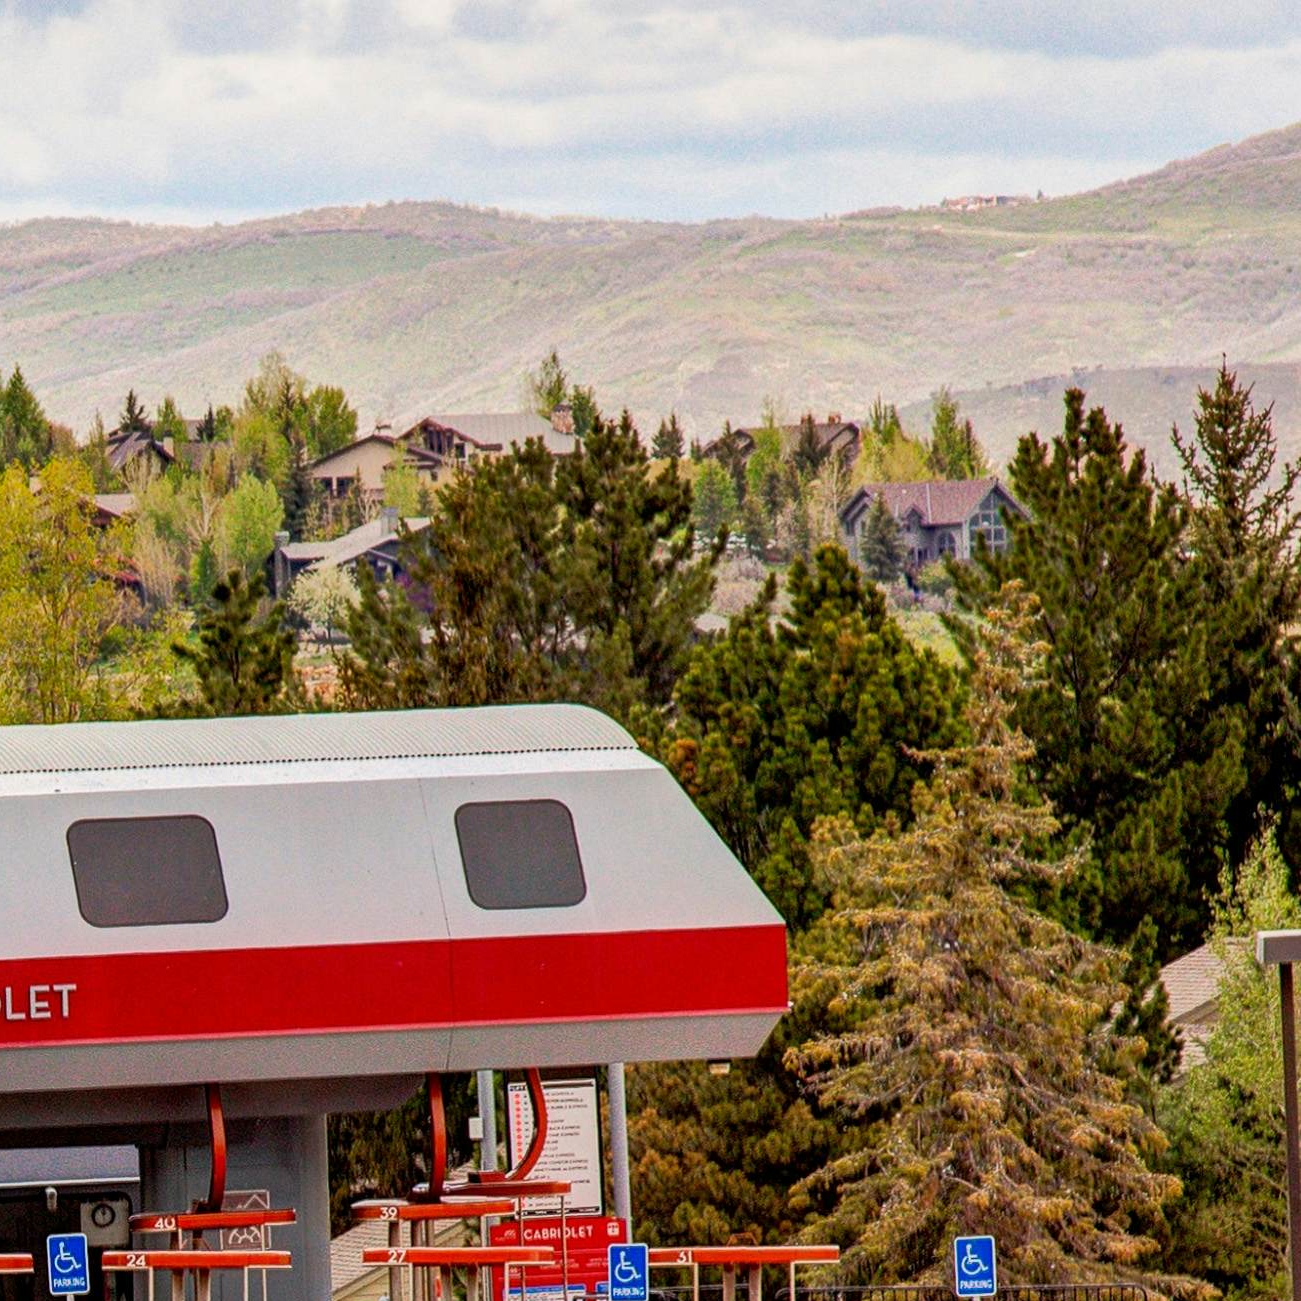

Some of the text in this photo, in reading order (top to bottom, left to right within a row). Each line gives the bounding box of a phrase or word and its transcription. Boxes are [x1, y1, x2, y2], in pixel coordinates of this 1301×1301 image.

[380, 1206, 398, 1220] 39
[154, 1217, 177, 1229] 40
[523, 1225, 594, 1240] CABRIOLET
[126, 1254, 146, 1267] 24
[388, 1250, 407, 1263] 27
[676, 1250, 693, 1263] 31
[53, 1276, 86, 1288] PARKING
[959, 1279, 993, 1290] PARKING
[612, 1286, 646, 1297] PARKING
